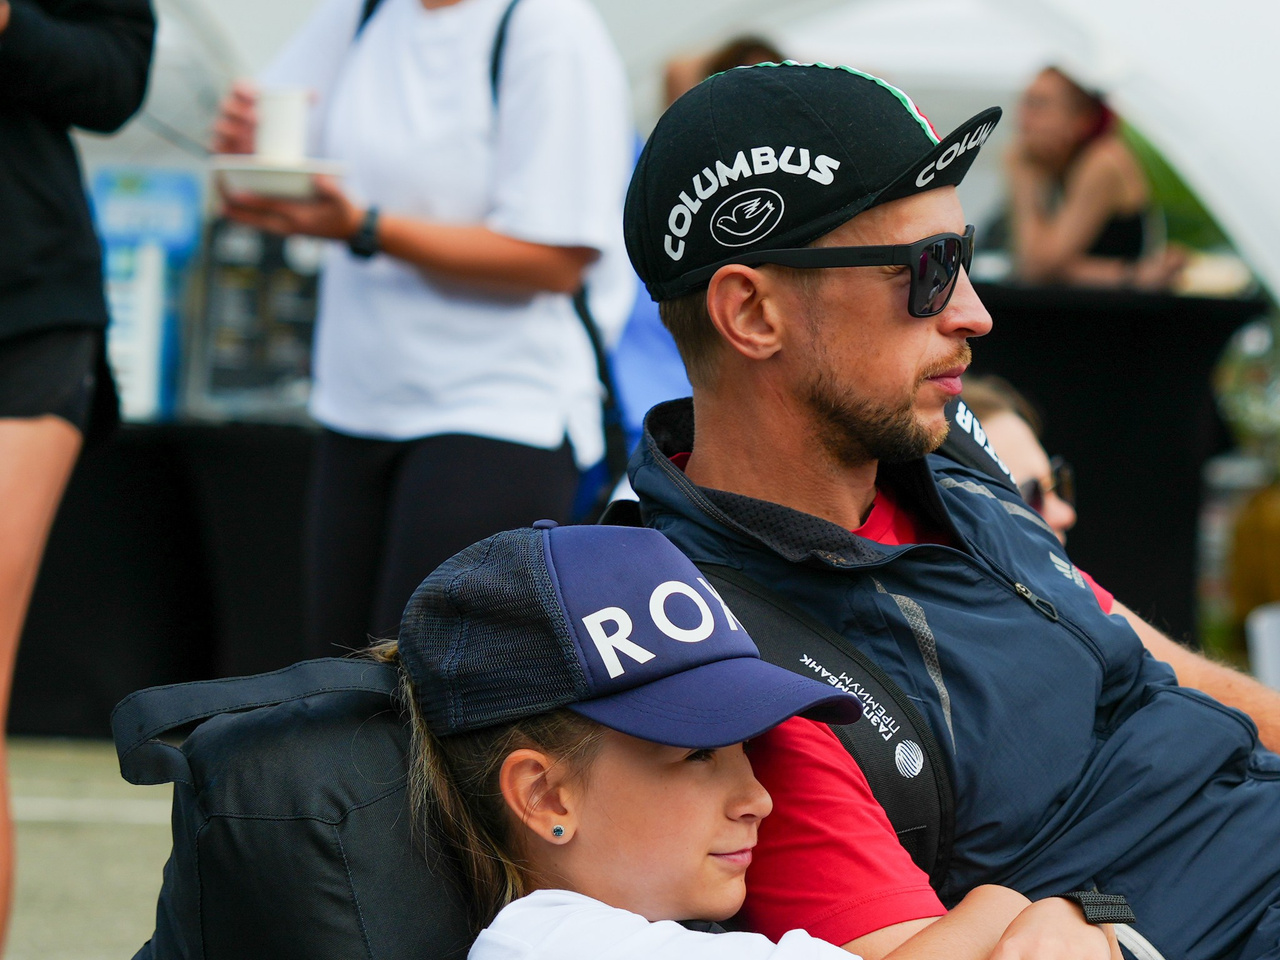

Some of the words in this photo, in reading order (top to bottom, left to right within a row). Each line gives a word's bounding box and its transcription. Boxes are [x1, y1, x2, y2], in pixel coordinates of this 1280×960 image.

[664, 146, 841, 261] COLUMBUS
[799, 654, 893, 741] ГАЗПМБАНК
[839, 672, 900, 734] ПРЕМИУМ
